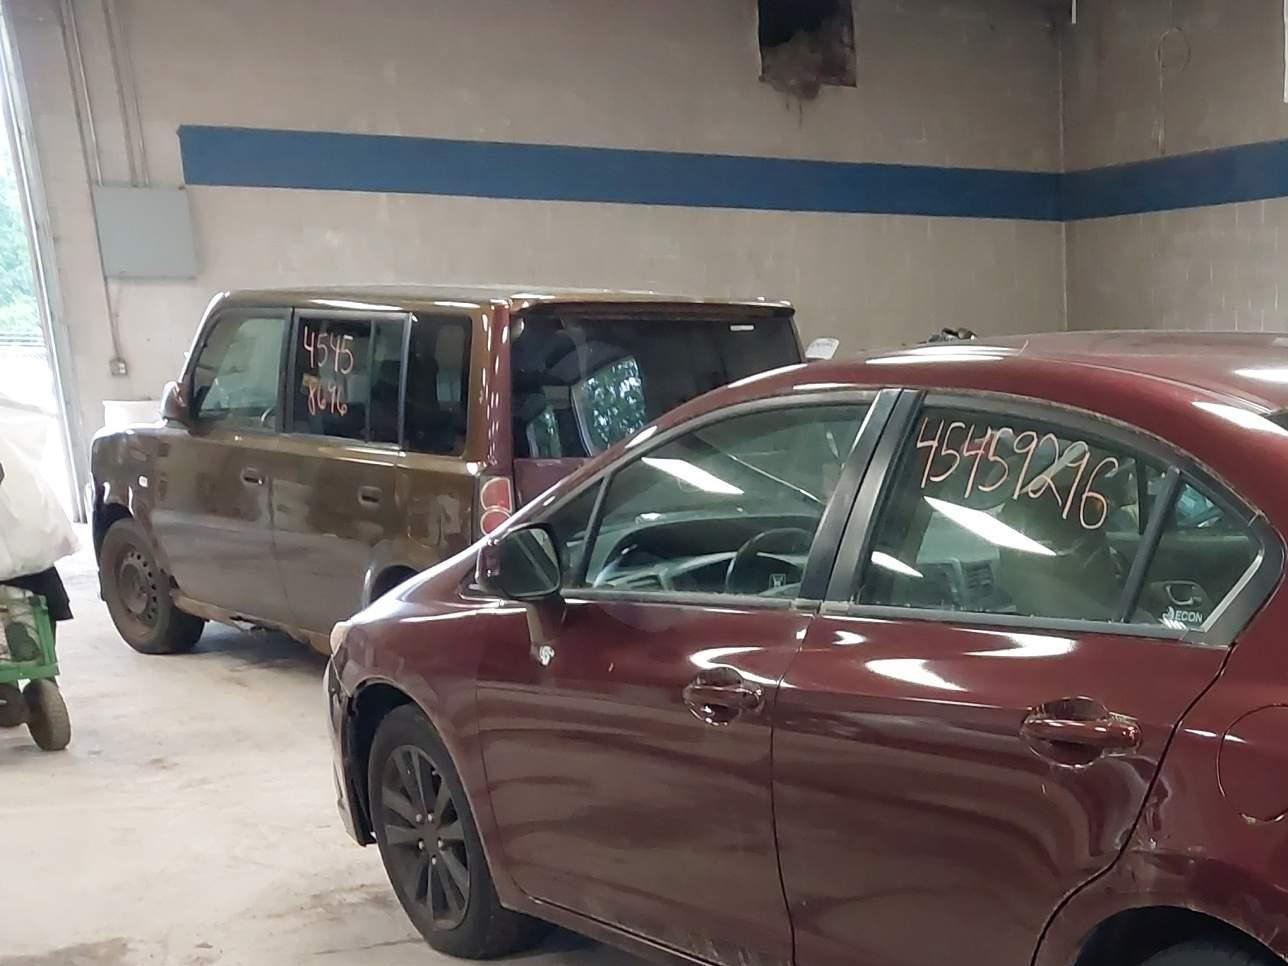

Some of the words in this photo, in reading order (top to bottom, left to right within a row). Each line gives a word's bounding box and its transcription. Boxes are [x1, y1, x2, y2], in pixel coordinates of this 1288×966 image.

[304, 325, 354, 375] 4545
[916, 416, 1119, 530] 45459296
[1174, 610, 1203, 623] ECON
